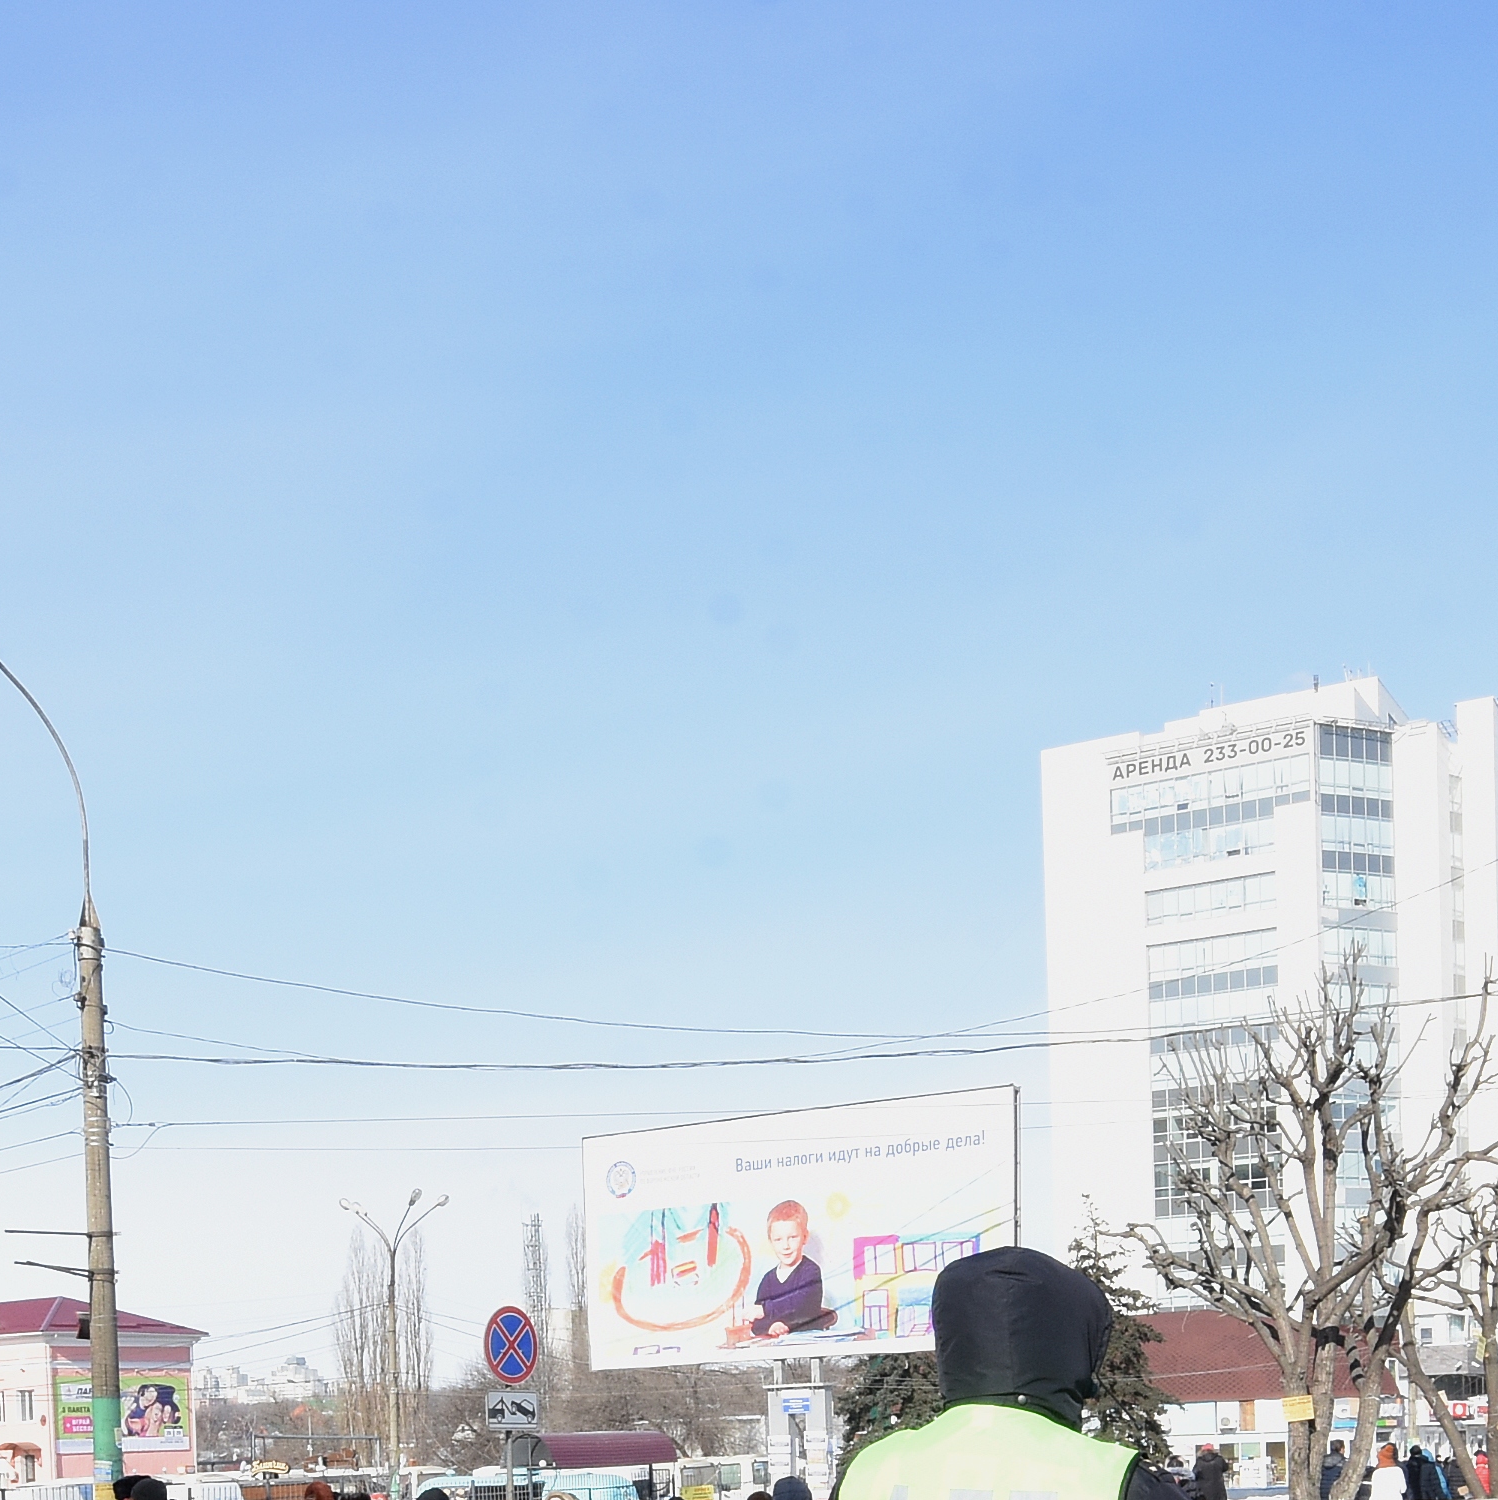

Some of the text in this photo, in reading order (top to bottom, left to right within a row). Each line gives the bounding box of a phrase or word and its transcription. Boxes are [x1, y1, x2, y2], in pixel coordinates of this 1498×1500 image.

[1112, 730, 1306, 781] АРЕНДА 233-00-25
[735, 1130, 986, 1172] Ваши налоги идут на добрые дела!
